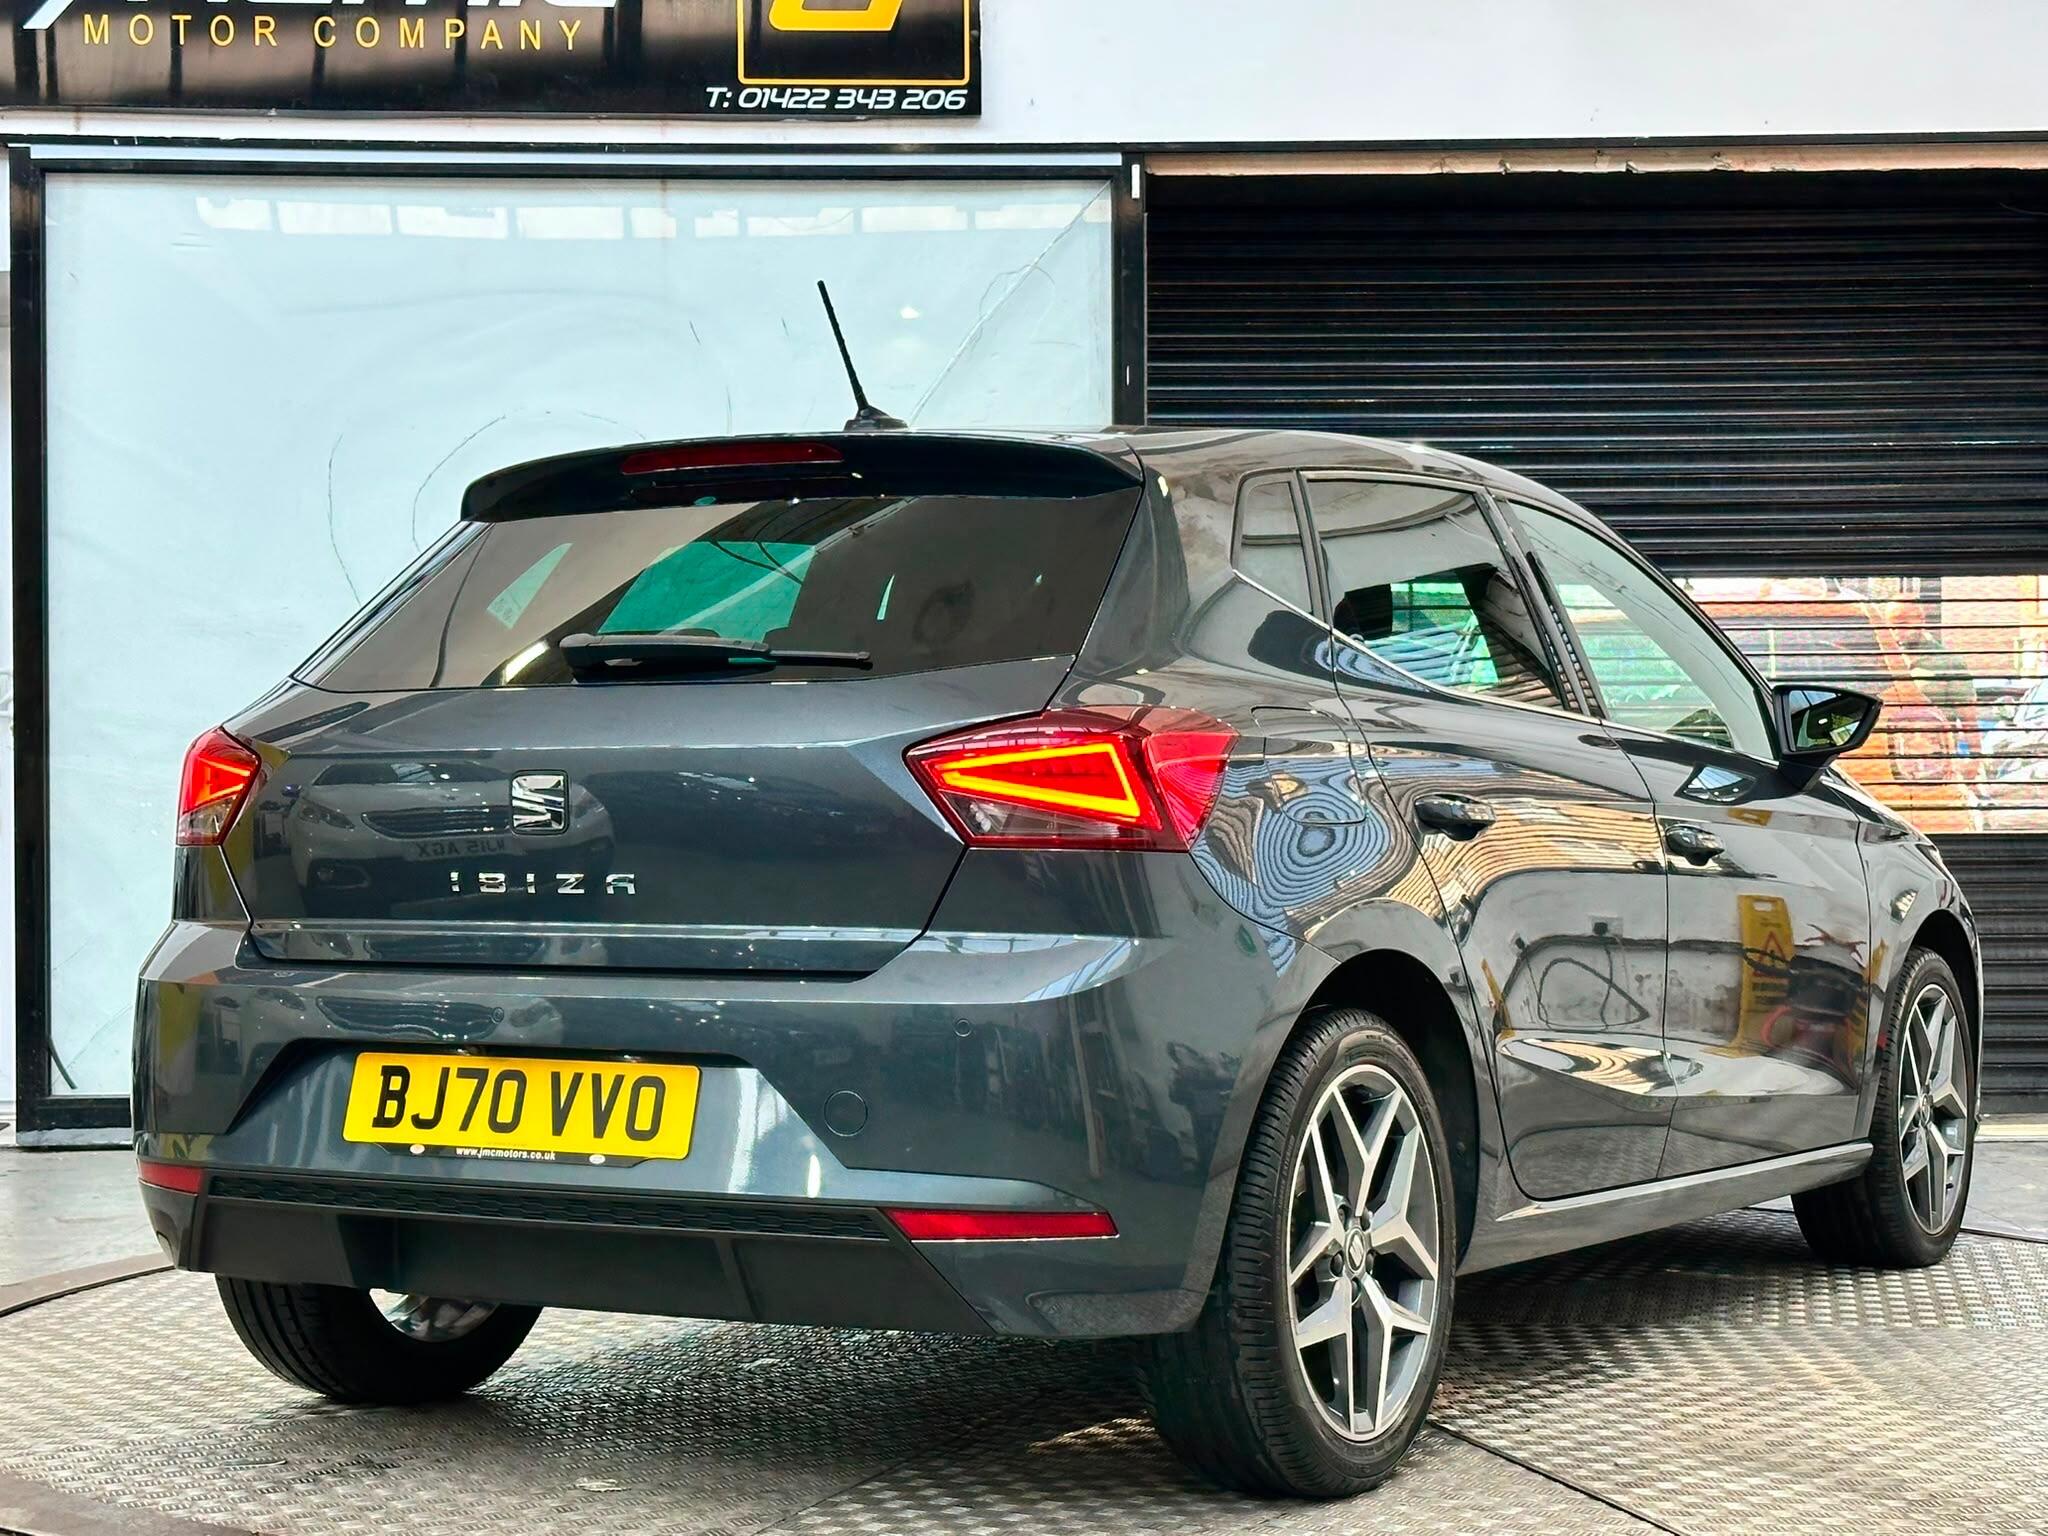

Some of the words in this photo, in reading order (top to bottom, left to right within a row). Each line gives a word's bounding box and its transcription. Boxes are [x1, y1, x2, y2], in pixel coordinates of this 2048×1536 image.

[83, 13, 277, 46] MOTOR
[313, 15, 582, 51] COMPANY
[705, 86, 733, 108] T:
[738, 87, 831, 109] 01422
[834, 88, 897, 110] 343
[900, 89, 968, 110] 206
[450, 871, 637, 895] IBIZA
[371, 1064, 528, 1134] BJ70
[549, 1070, 667, 1142] VVO
[455, 1147, 556, 1161] www.jmcmotors.co.uk
